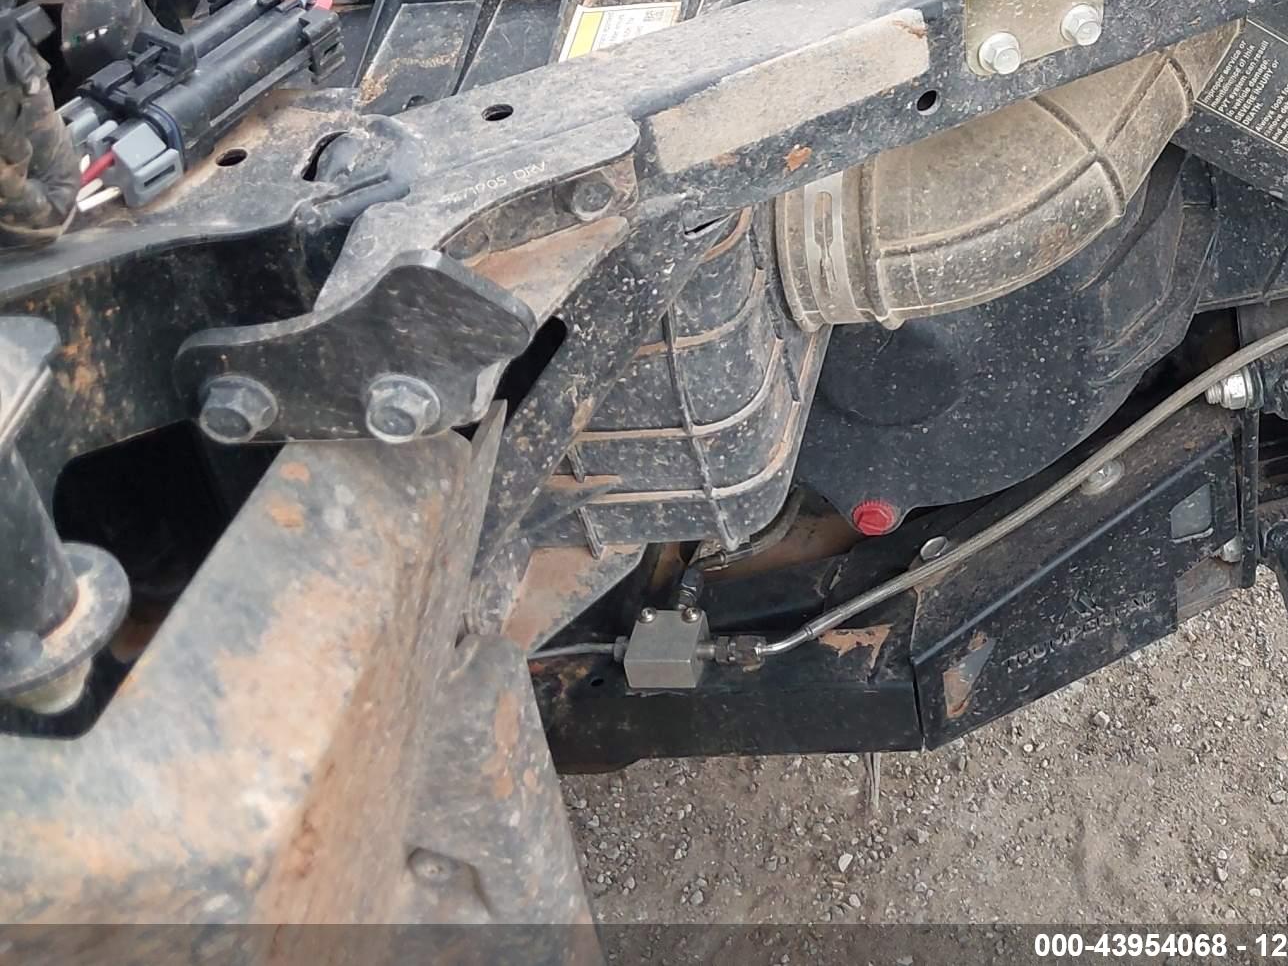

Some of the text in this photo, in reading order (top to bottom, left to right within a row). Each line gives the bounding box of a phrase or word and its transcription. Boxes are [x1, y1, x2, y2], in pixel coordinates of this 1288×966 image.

[1202, 40, 1246, 103] Improper service or
[1239, 58, 1246, 68] of
[1243, 45, 1255, 59] this
[1218, 40, 1269, 112] PVT system can result
[1234, 59, 1279, 121] SEVERE INJURY or
[1232, 87, 1251, 110] vehicle
[1255, 110, 1274, 132] Always
[1271, 95, 1285, 110] look
[1272, 127, 1283, 141] and
